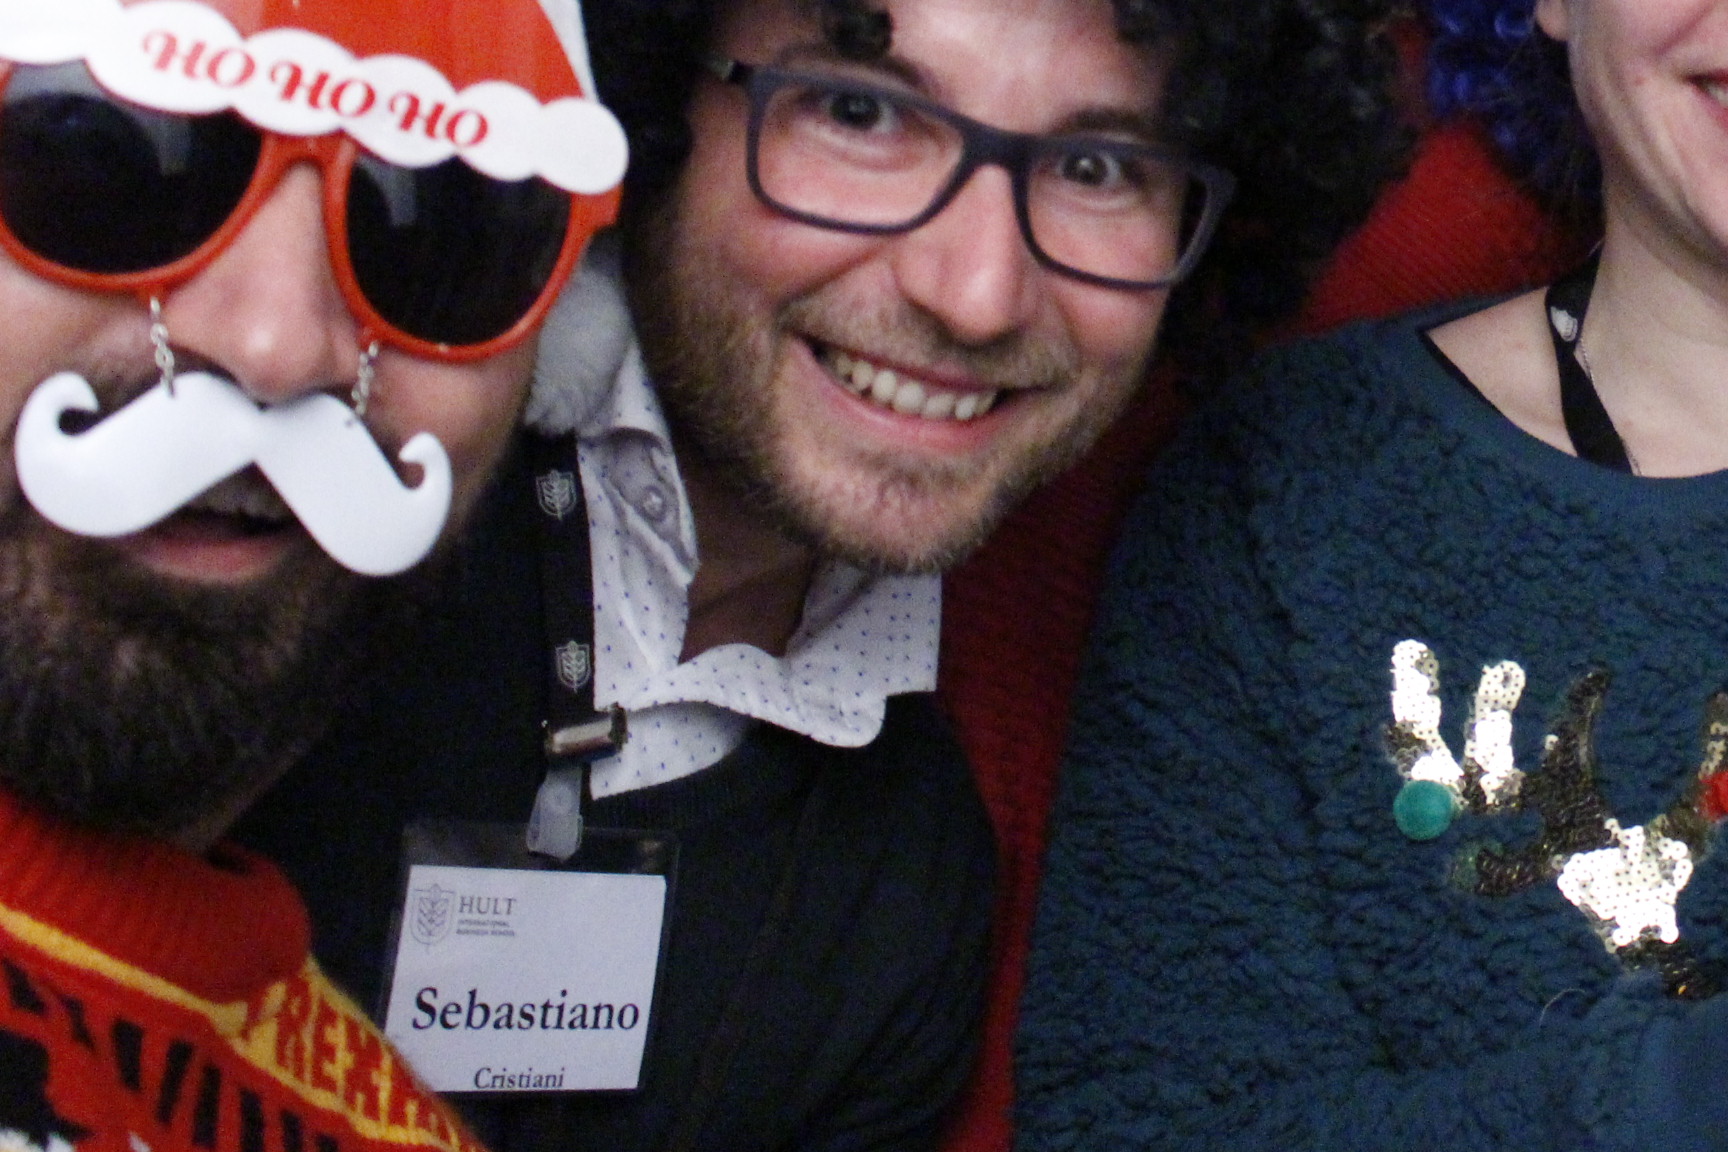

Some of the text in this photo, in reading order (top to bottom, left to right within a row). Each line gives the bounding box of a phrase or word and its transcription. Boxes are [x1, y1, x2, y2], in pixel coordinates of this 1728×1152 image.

[141, 29, 489, 148] HO HO HO
[459, 895, 517, 915] HULT
[411, 985, 641, 1031] Sebastiano
[473, 1066, 566, 1090] Cristiani
